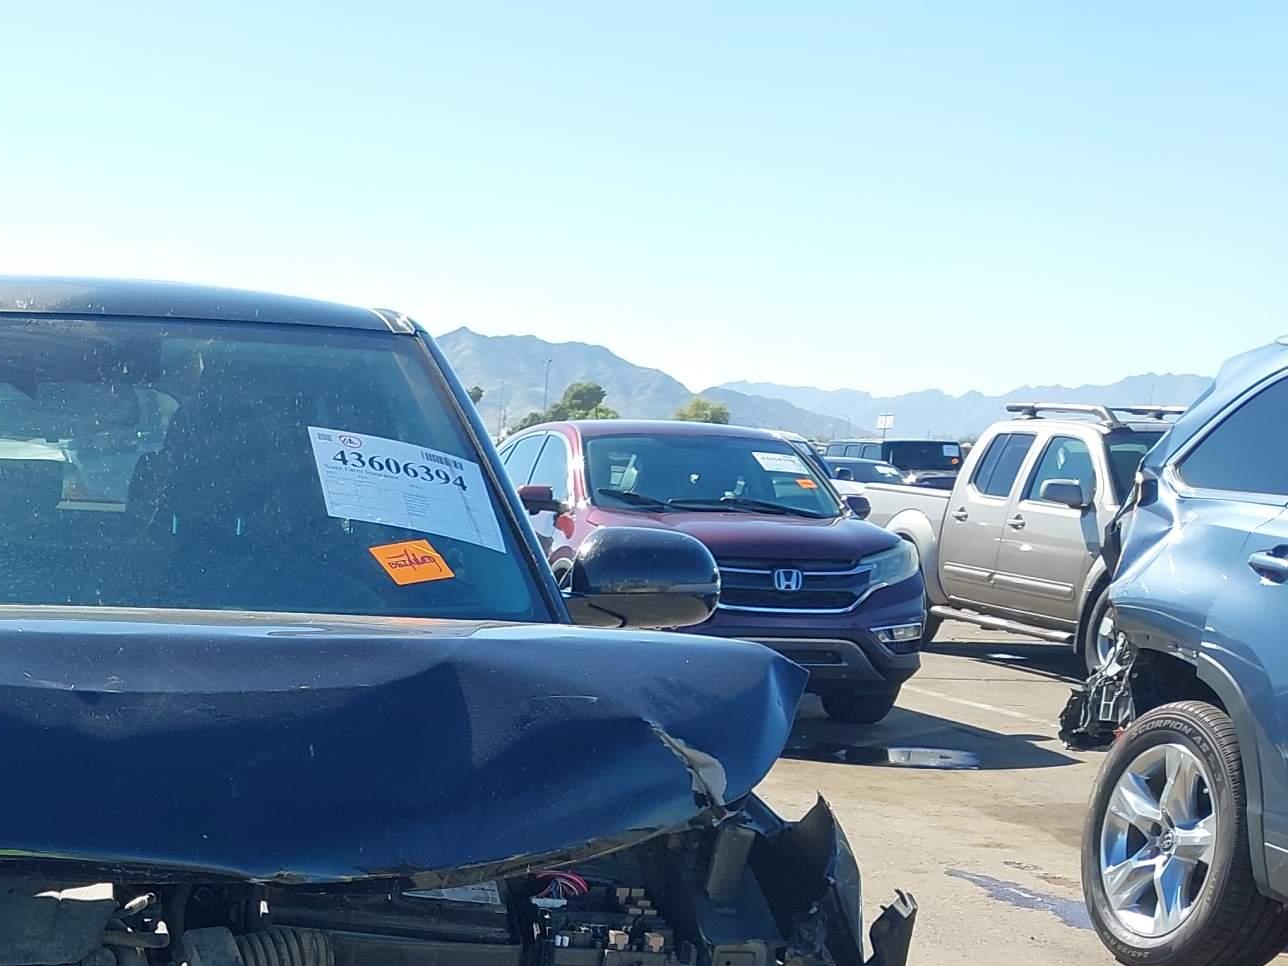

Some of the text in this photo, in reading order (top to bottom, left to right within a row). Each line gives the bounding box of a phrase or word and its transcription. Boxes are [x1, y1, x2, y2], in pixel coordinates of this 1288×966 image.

[332, 449, 468, 491] 43606394
[1130, 719, 1210, 753] SCORPION AS
